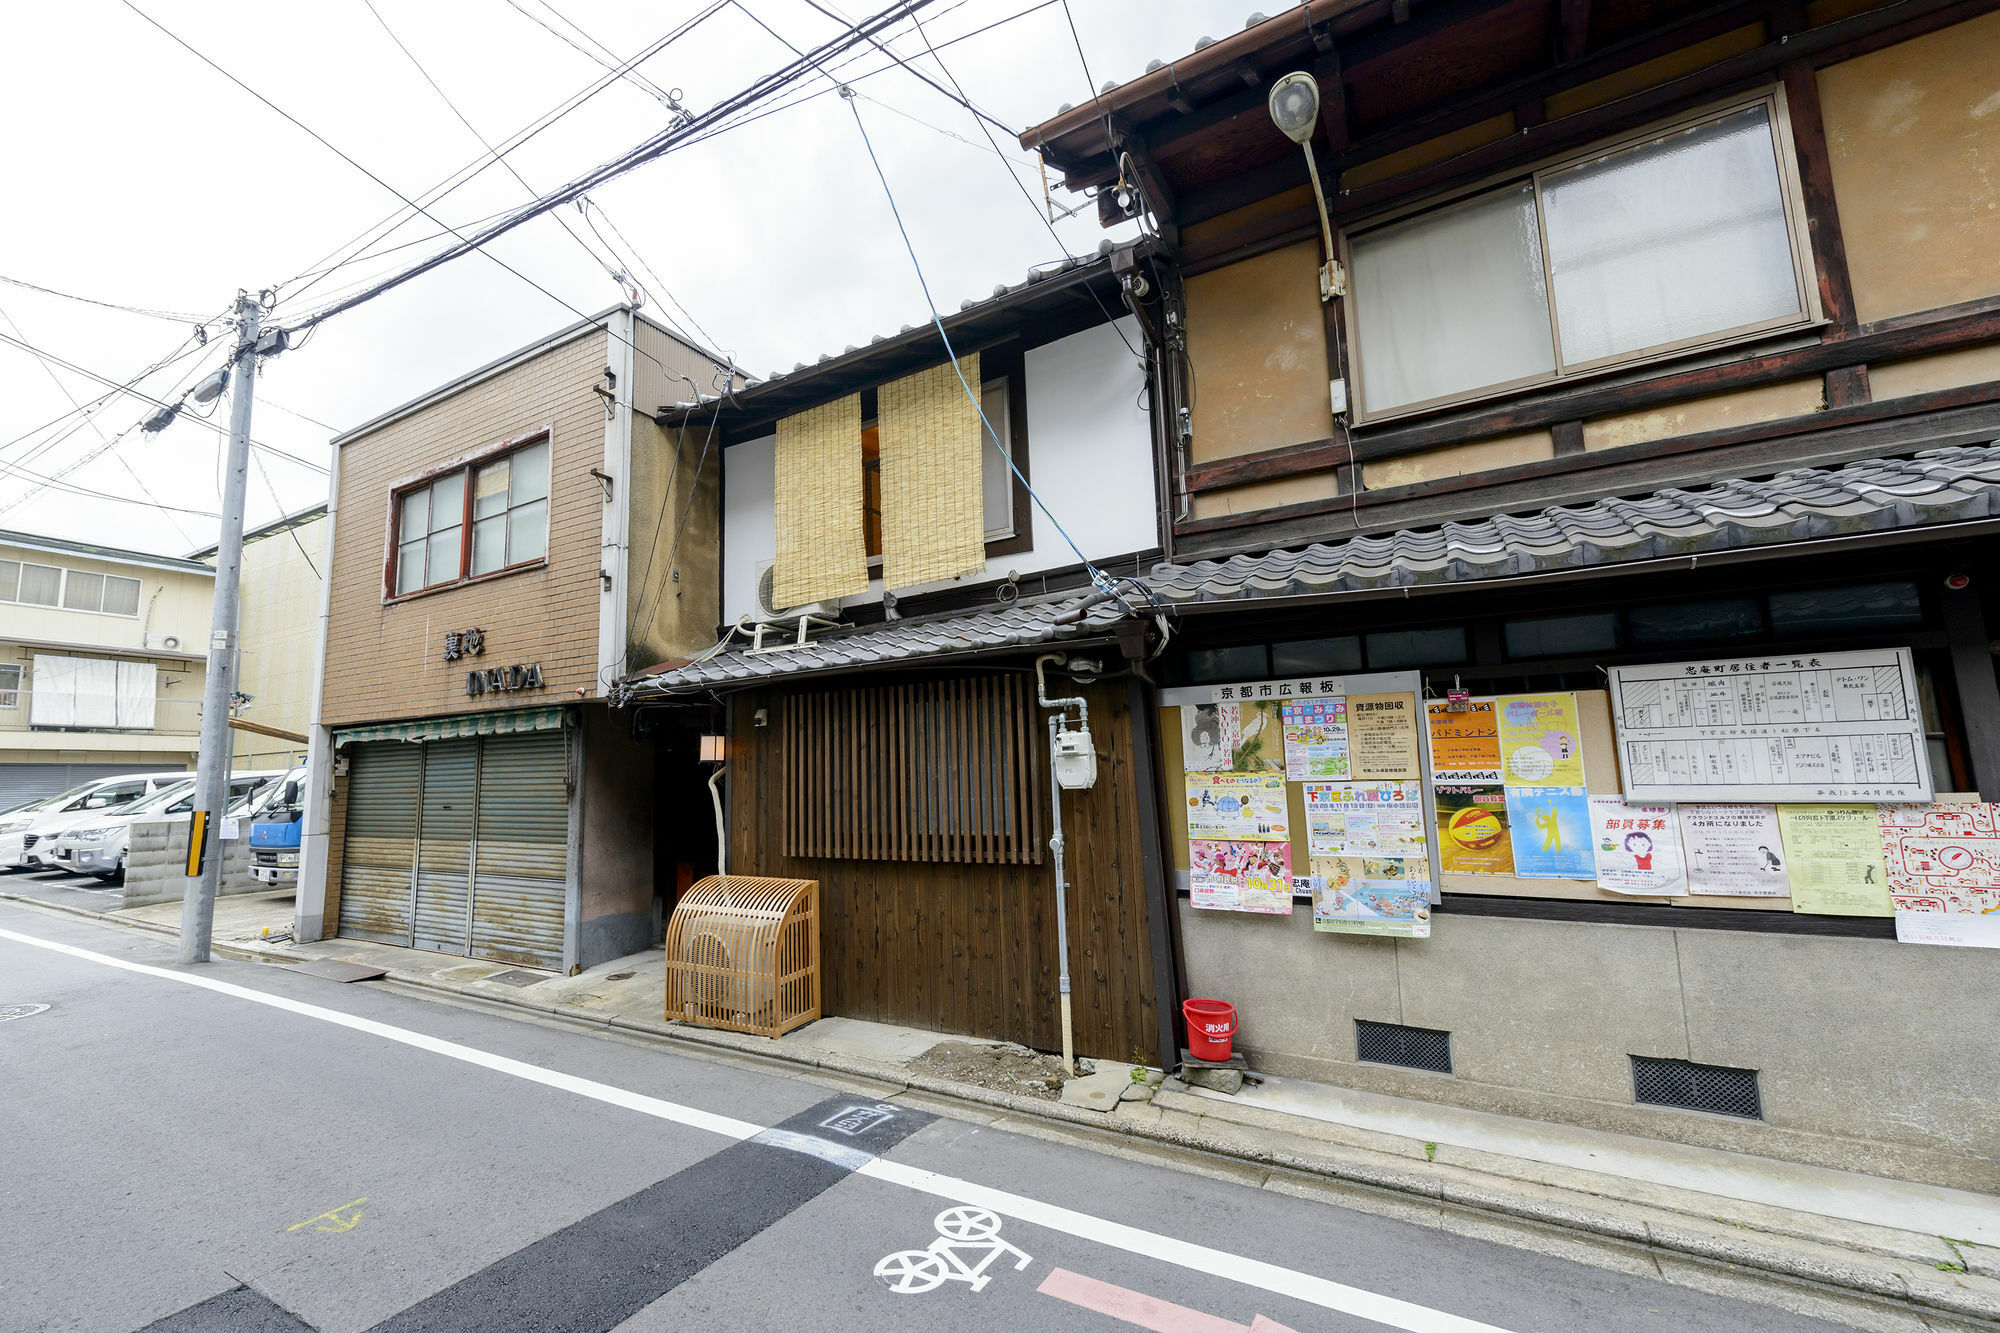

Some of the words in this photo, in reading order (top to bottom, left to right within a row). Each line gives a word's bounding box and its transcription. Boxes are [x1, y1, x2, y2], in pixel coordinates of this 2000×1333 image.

[1685, 657, 1822, 675] 忠庵町居住者一覧表
[466, 664, 544, 695] INADA
[1221, 681, 1333, 699] 京都市広報板
[1355, 701, 1404, 712] 資源物回収
[1432, 728, 1497, 737] バドミントン
[1605, 818, 1667, 831] 部員募集
[1246, 877, 1291, 891] 10月31日
[1205, 1022, 1230, 1033] 消火用
